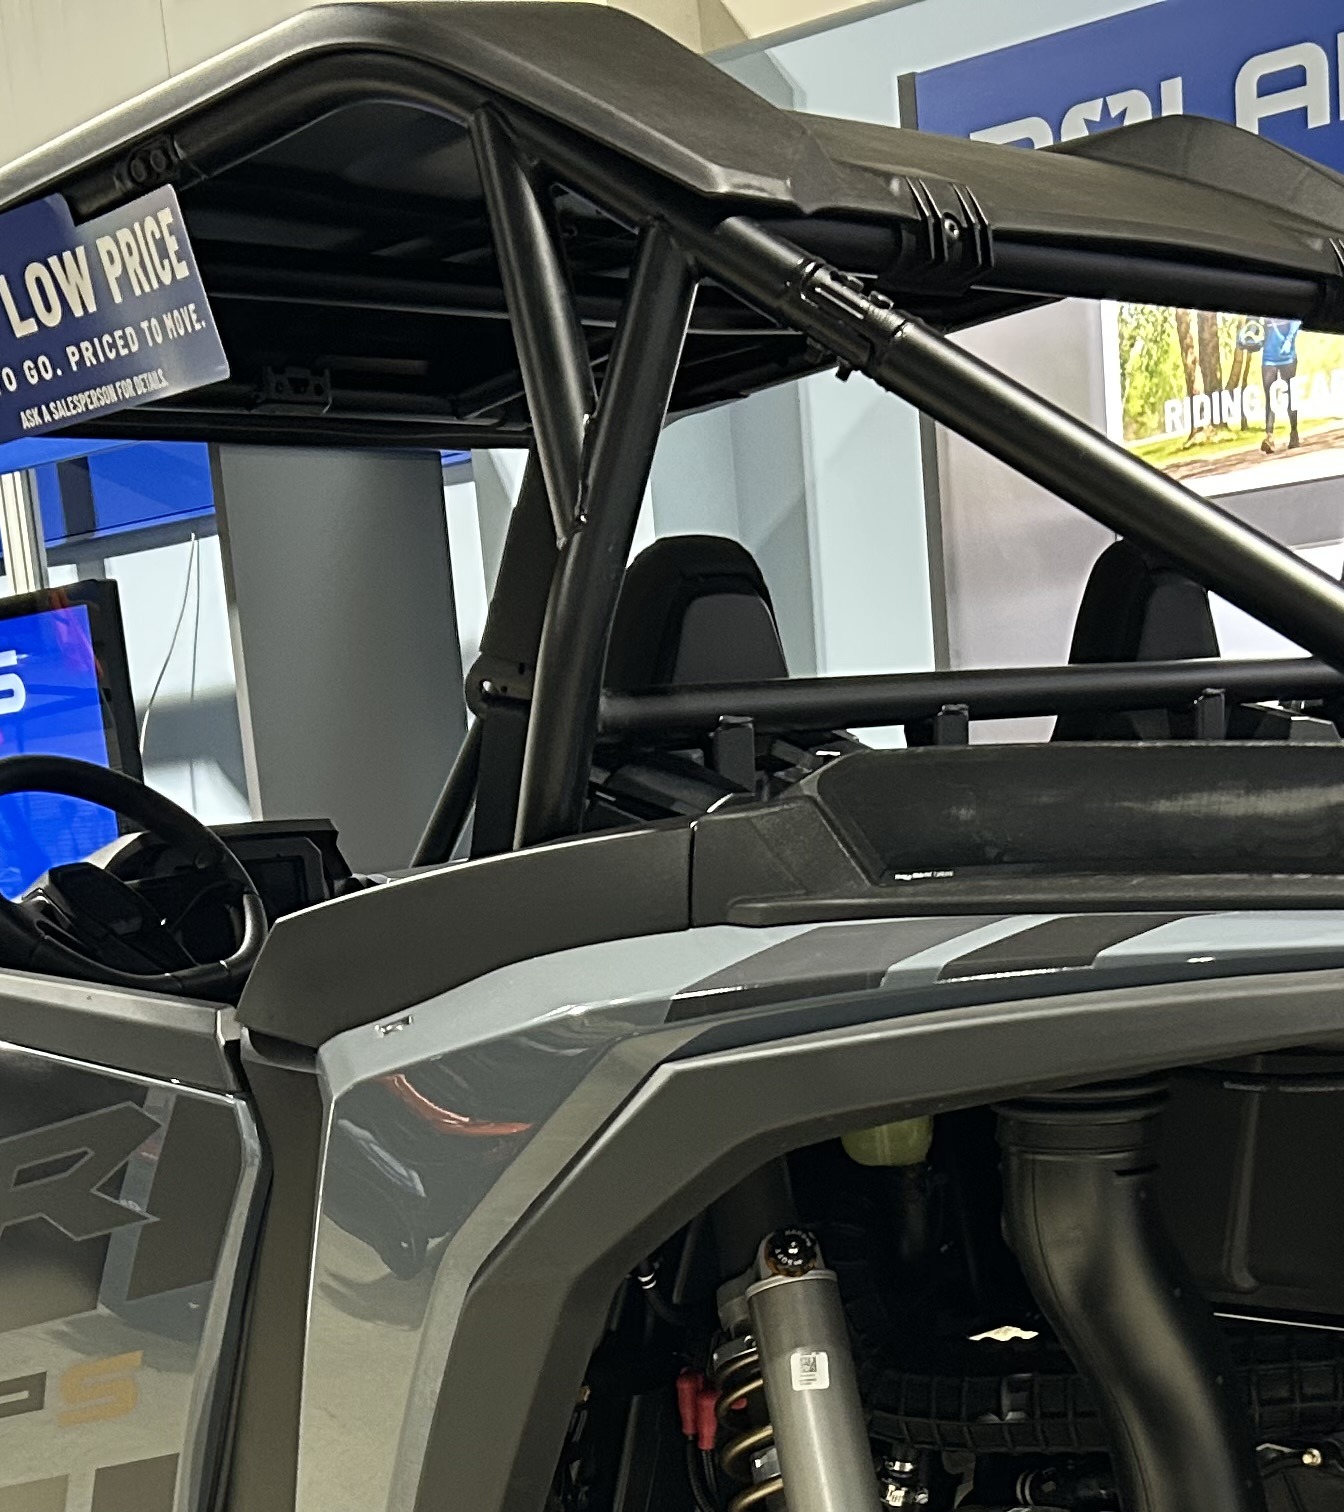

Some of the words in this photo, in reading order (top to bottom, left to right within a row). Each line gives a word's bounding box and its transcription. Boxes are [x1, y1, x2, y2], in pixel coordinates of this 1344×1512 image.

[96, 207, 190, 304] PRICE
[23, 354, 63, 386] GO.
[66, 325, 140, 371] PRICED
[141, 318, 163, 347] TO
[162, 302, 206, 340] MOVE.
[20, 406, 42, 430] ASK
[42, 402, 52, 423] A
[52, 384, 116, 421] SALESPERSON
[115, 378, 135, 400] FOR
[1164, 382, 1260, 433] RIDING
